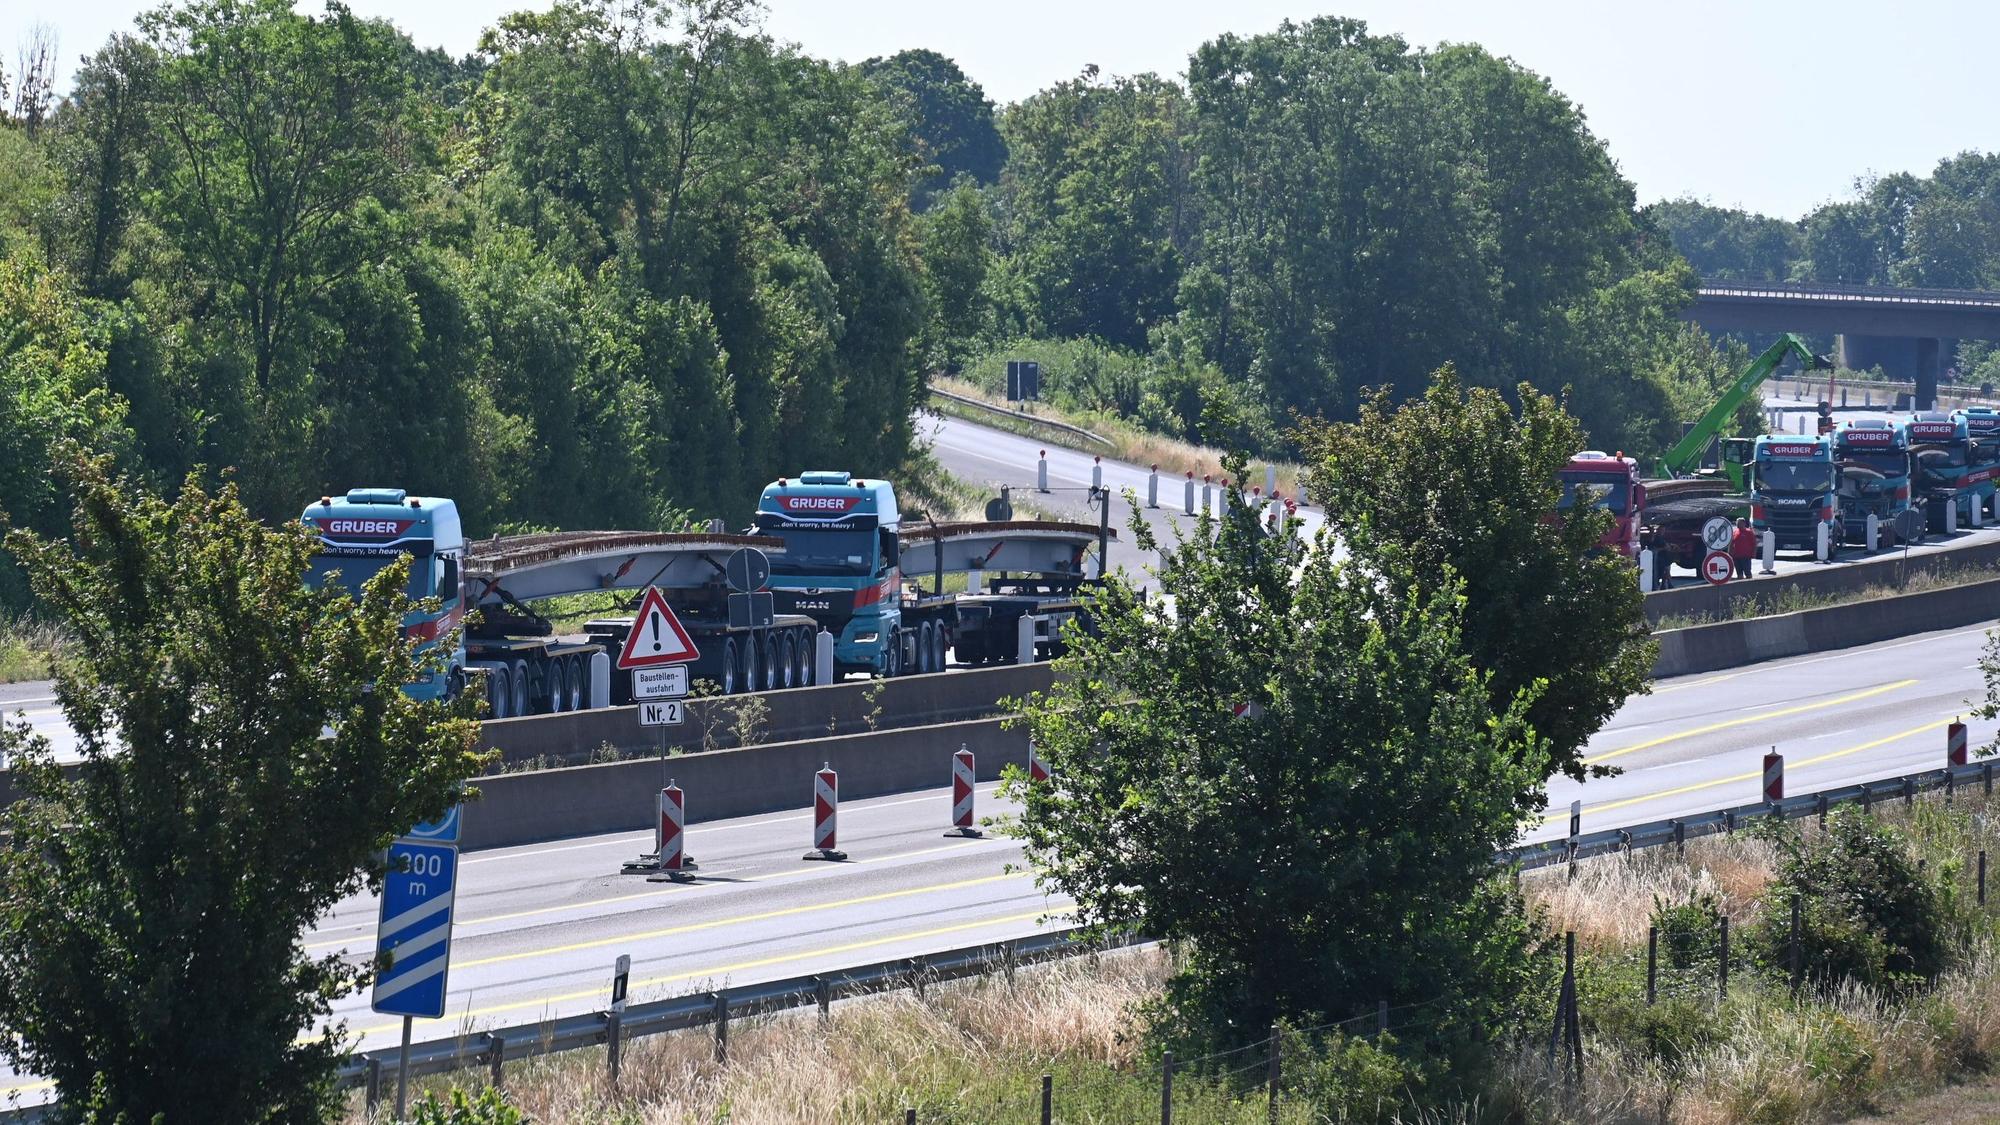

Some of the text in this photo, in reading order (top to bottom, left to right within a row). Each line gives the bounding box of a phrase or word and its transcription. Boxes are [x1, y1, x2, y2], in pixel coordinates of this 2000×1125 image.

[1913, 425, 1952, 433] GRUBER
[1847, 433, 1889, 441] GRUBER
[1774, 446, 1811, 454] GRUBER
[789, 497, 845, 509] GRUBER
[329, 520, 397, 533] GRUBER
[831, 522, 851, 530] heavy
[1708, 525, 1728, 543] 80
[323, 546, 342, 554] don't
[343, 547, 366, 555] worry,
[378, 547, 403, 556] heavy
[795, 601, 830, 609] MAN
[640, 672, 680, 683] Baustellen-
[646, 684, 674, 694] ausfahrt
[646, 704, 677, 723] Nr. 2
[409, 881, 426, 896] m
